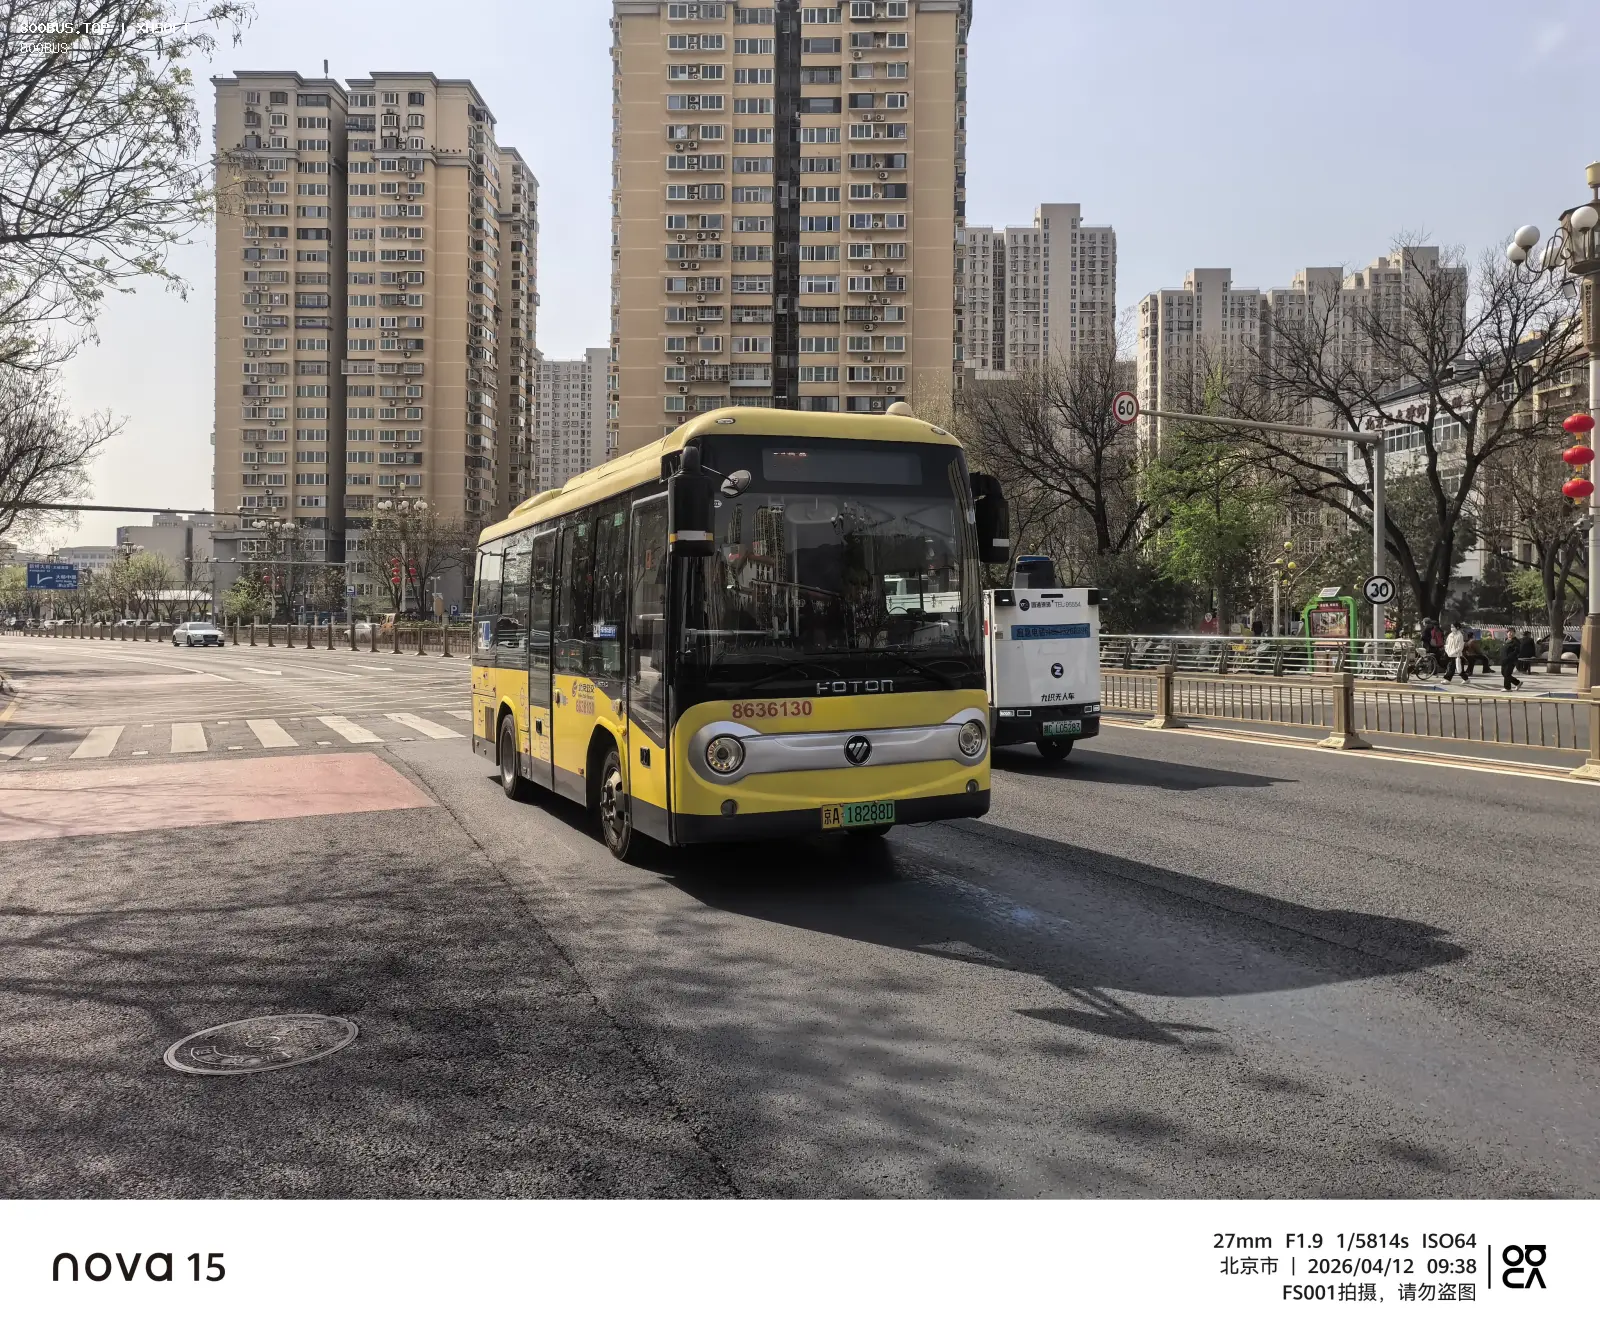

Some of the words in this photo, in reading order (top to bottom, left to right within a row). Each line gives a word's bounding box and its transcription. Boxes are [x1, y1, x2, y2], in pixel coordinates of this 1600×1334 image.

[1118, 400, 1134, 416] 60
[1370, 582, 1389, 598] 30
[816, 679, 894, 695] FOTON
[1040, 692, 1075, 702] 九识无人车
[732, 700, 813, 719] 8636130
